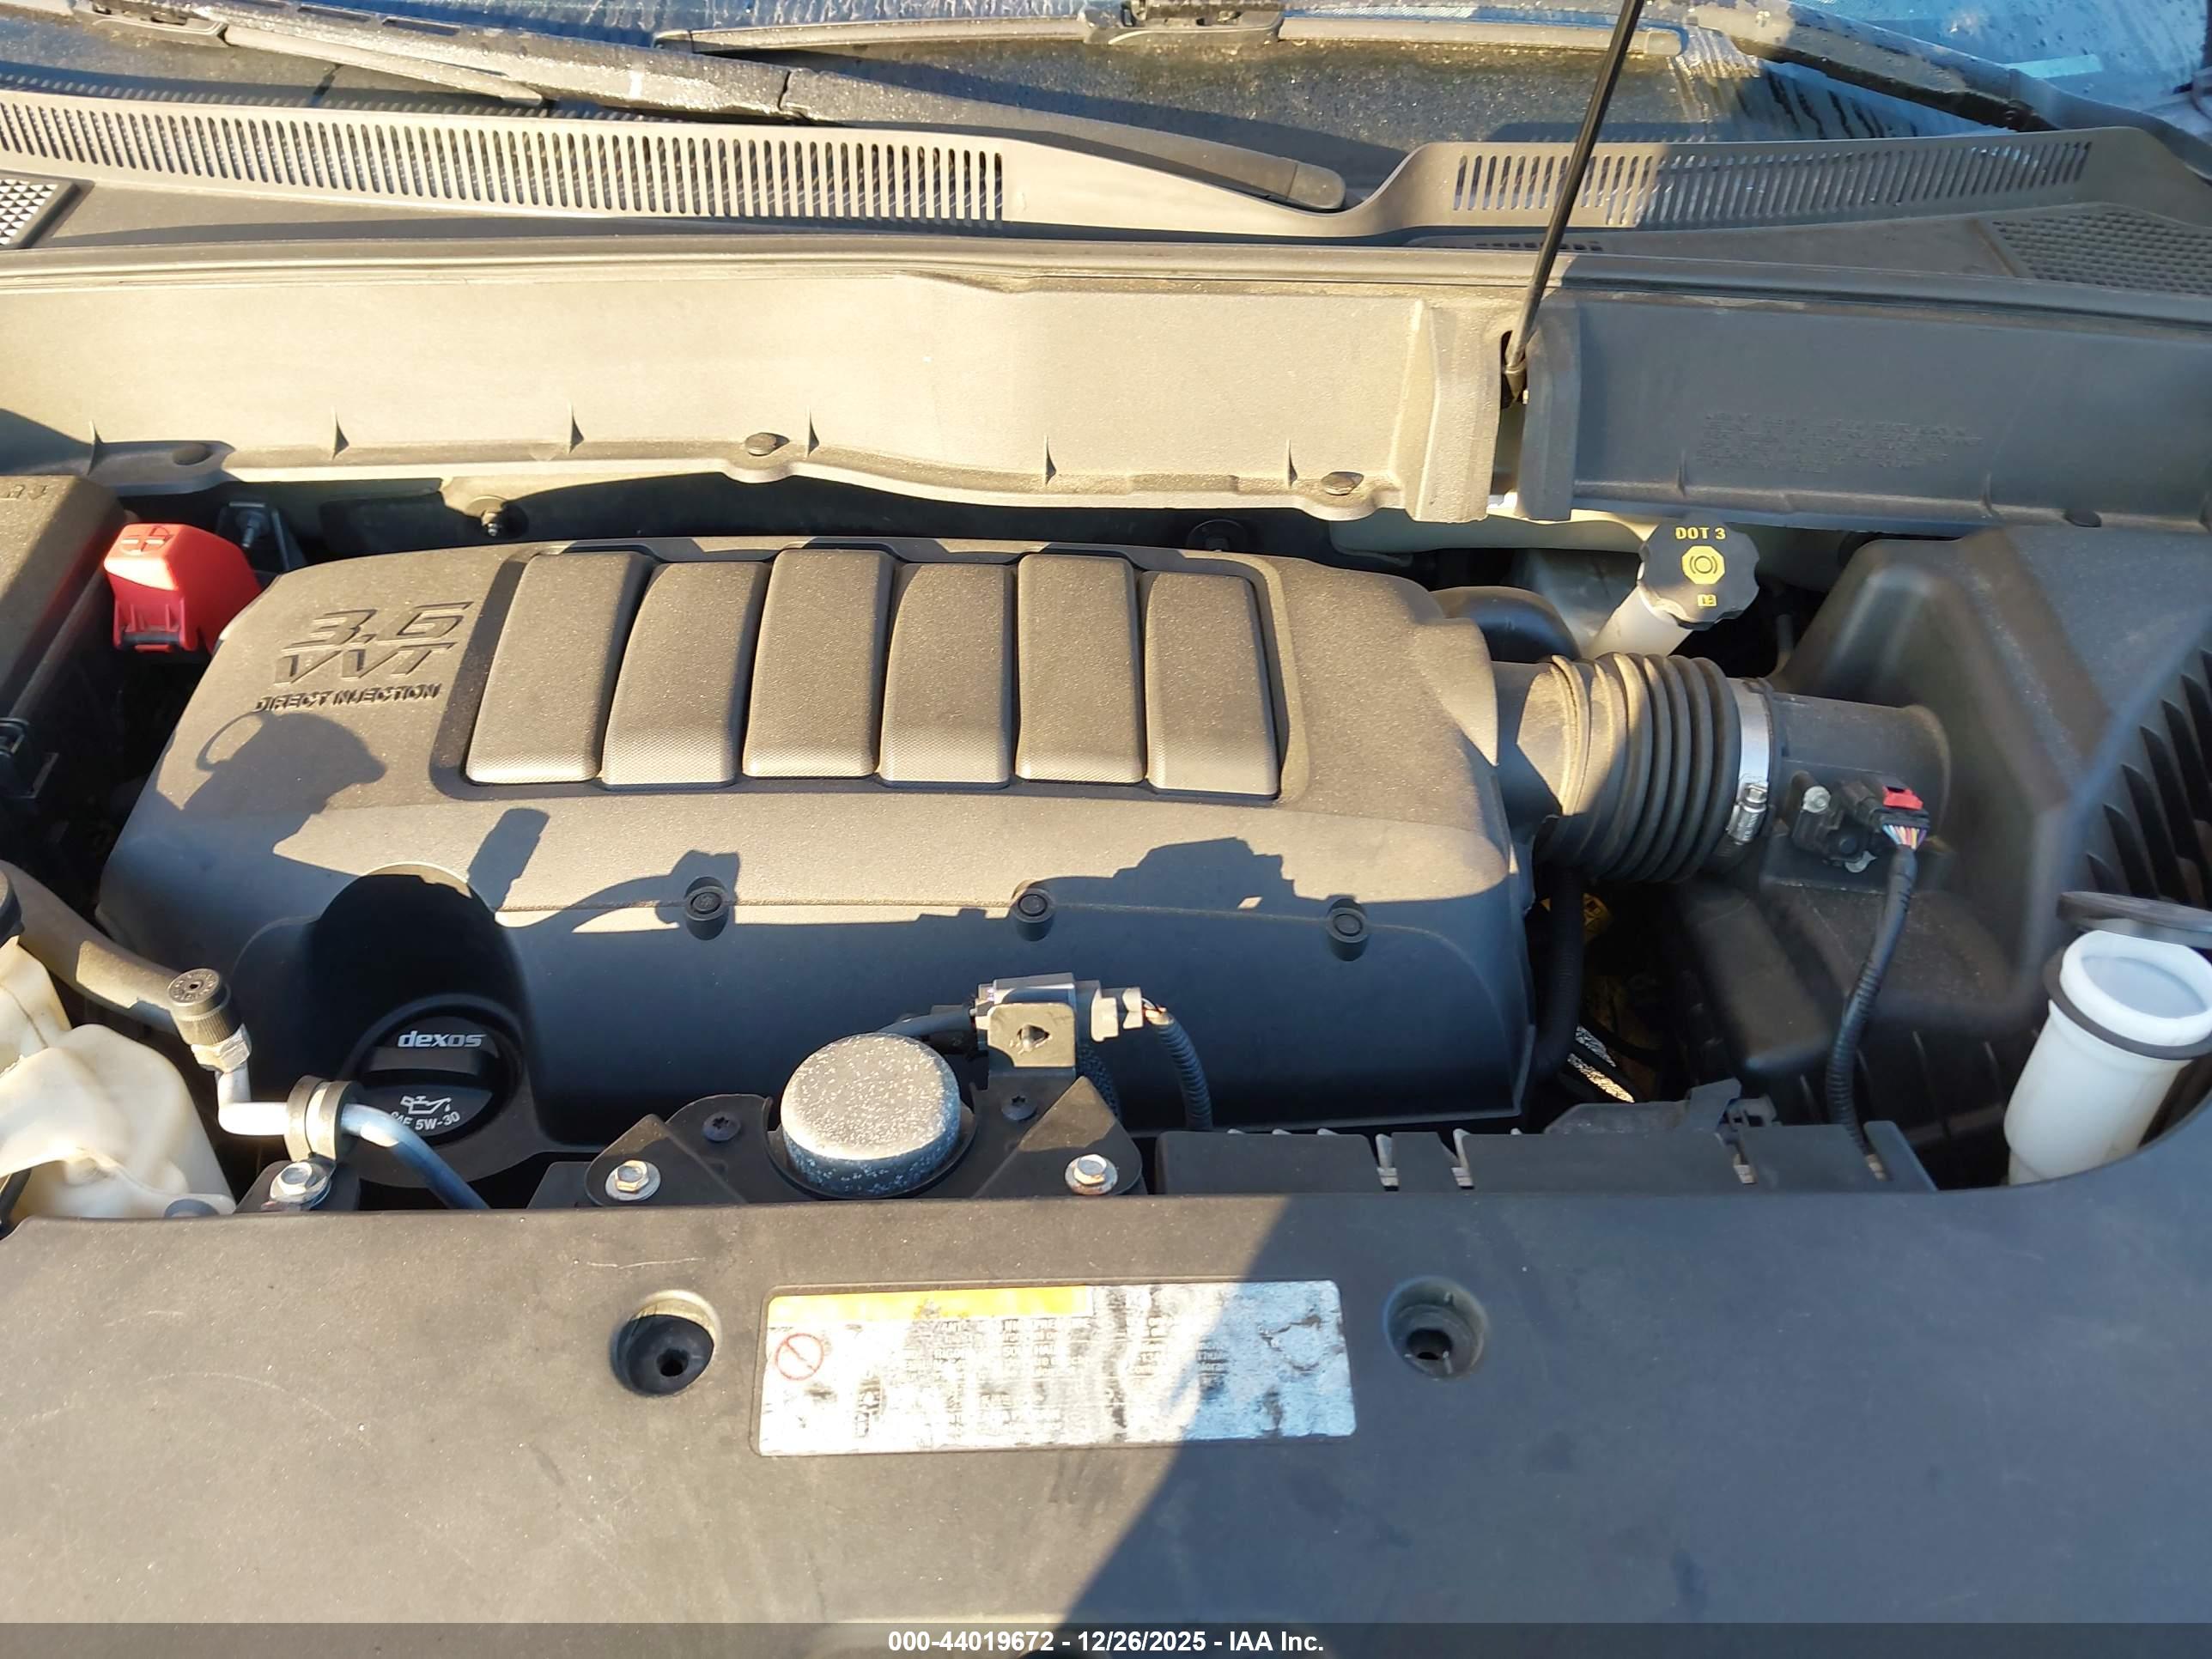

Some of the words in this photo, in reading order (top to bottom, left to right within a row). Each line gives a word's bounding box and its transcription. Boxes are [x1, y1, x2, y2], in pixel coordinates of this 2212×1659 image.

[1675, 526, 1710, 539] DOT
[1715, 526, 1726, 539] 3
[283, 601, 474, 649] 3.6
[274, 641, 458, 685] VVT
[252, 690, 332, 713] DIRECT
[333, 683, 442, 706] INJECTION
[398, 1030, 487, 1048] dexos
[415, 1111, 460, 1130] 5W-30
